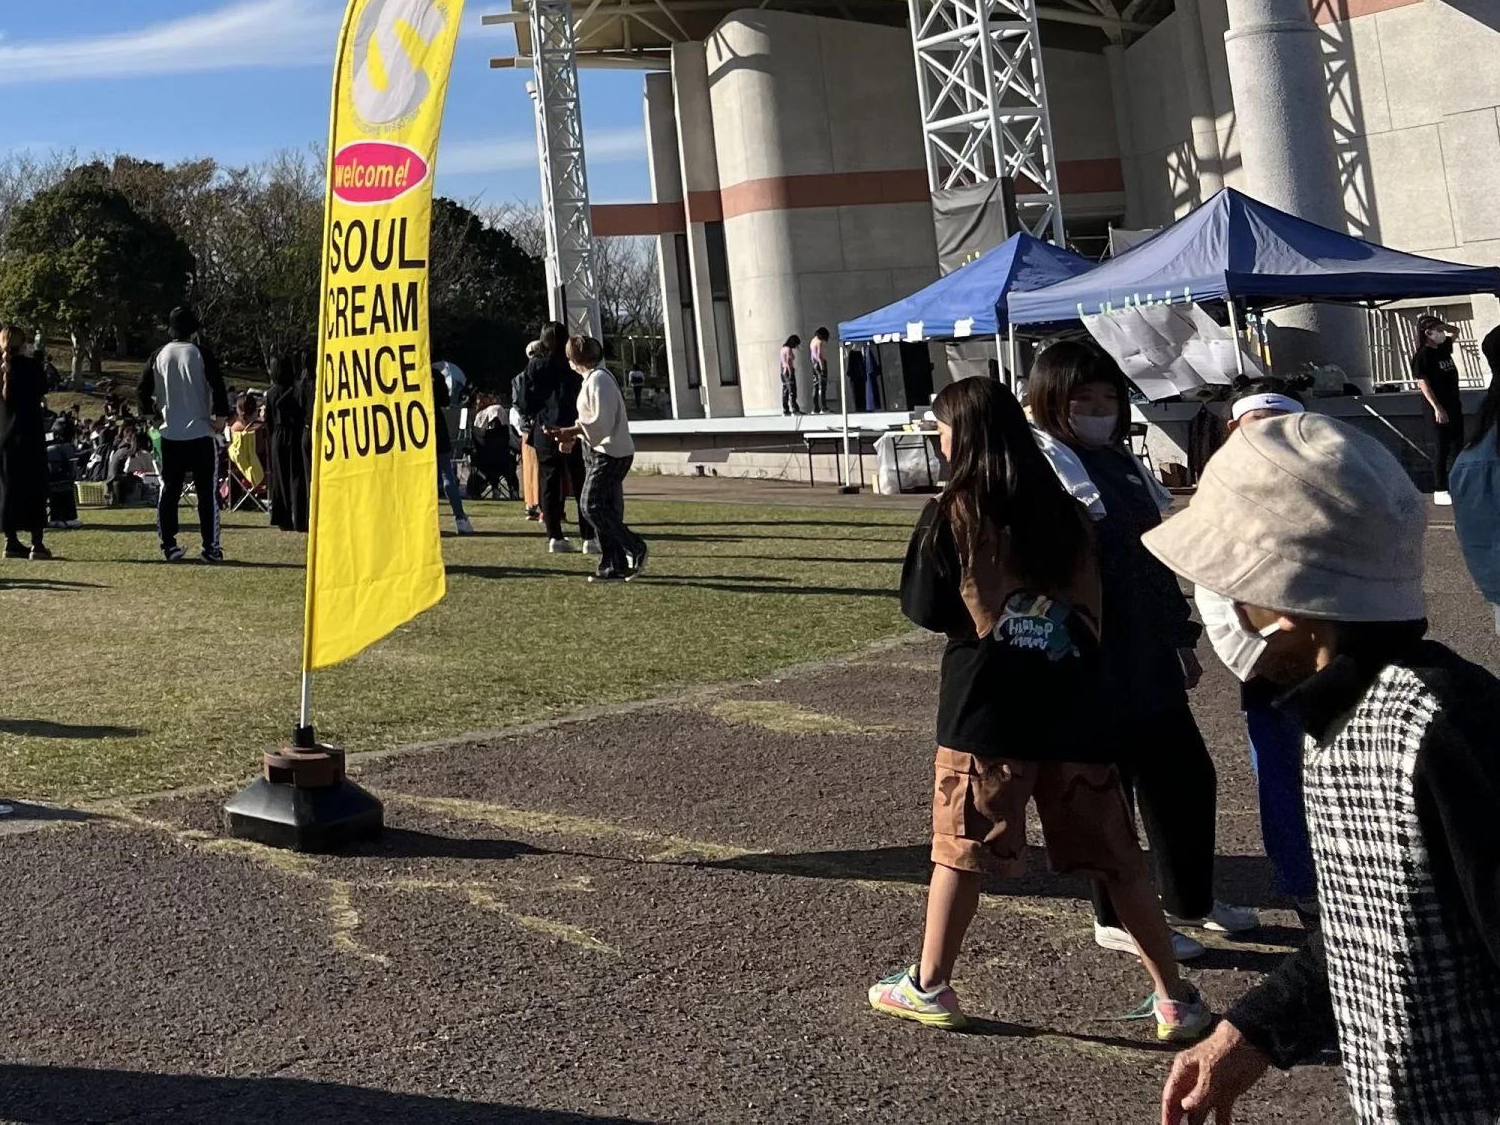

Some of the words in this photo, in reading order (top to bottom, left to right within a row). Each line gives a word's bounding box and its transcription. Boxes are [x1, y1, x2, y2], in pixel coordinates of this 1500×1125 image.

[334, 157, 411, 188] welcome!
[330, 216, 426, 275] SOUL
[326, 281, 418, 340] CREAM
[324, 344, 421, 404] DANCE
[324, 400, 429, 462] STUDIO
